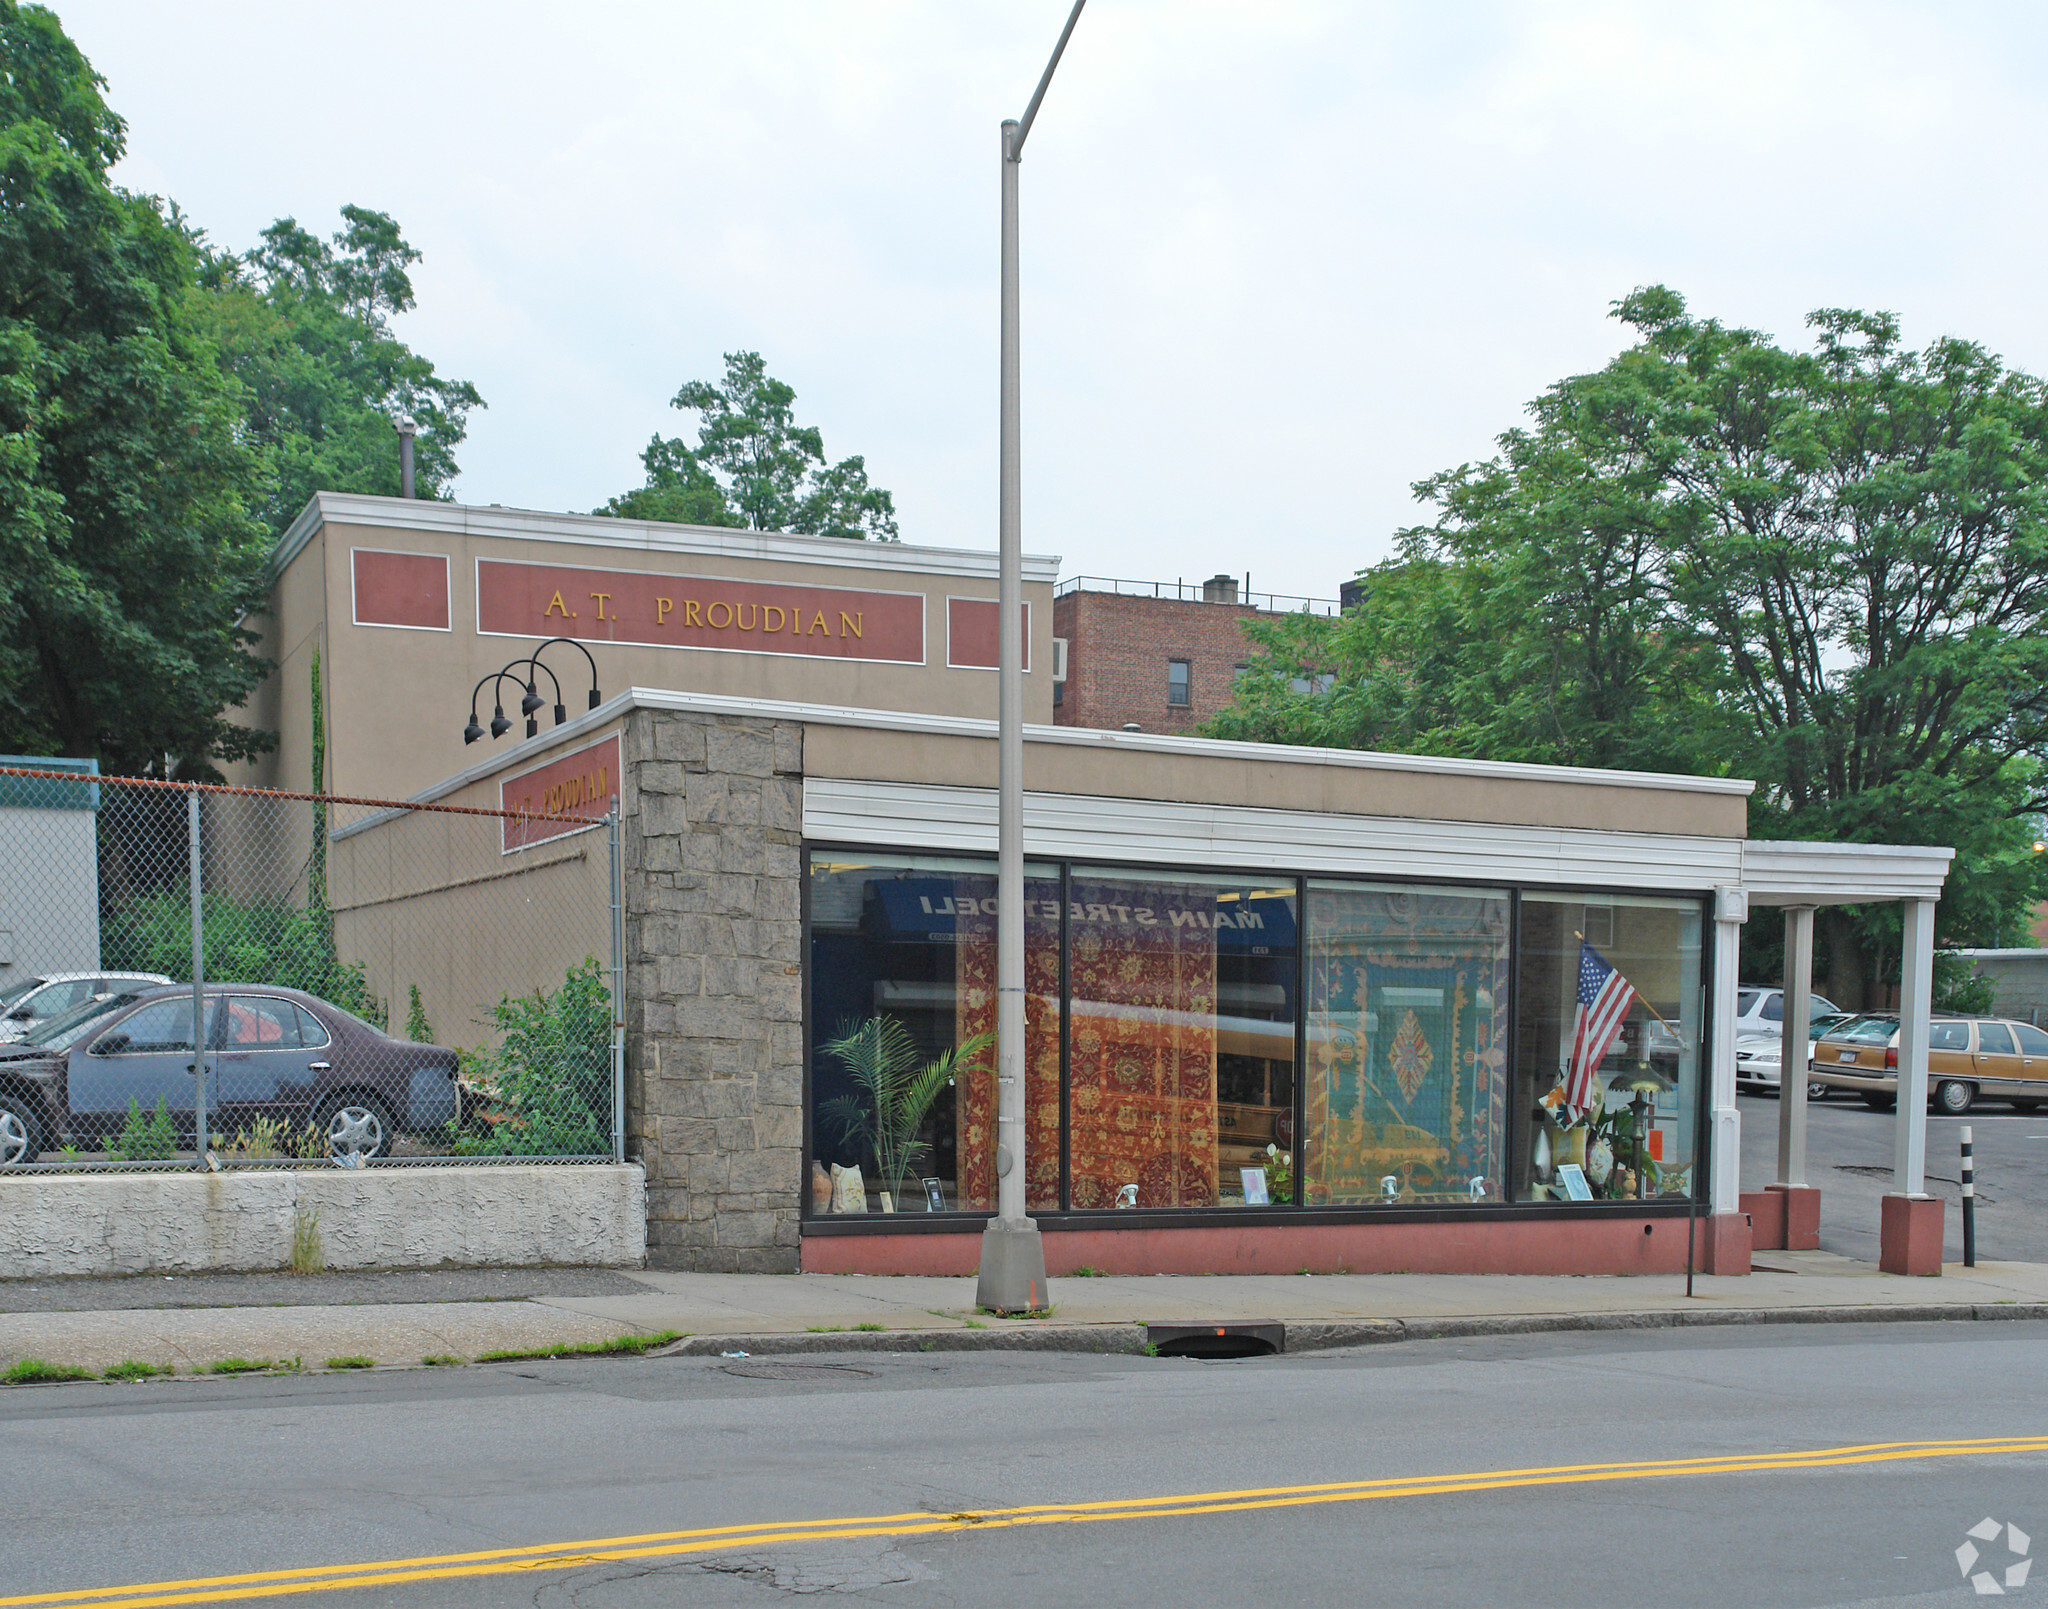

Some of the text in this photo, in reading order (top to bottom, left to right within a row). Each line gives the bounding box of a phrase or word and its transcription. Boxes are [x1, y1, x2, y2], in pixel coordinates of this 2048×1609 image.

[544, 590, 864, 638] A. T. PROUDIAN
[543, 765, 607, 814] PROUDIAN
